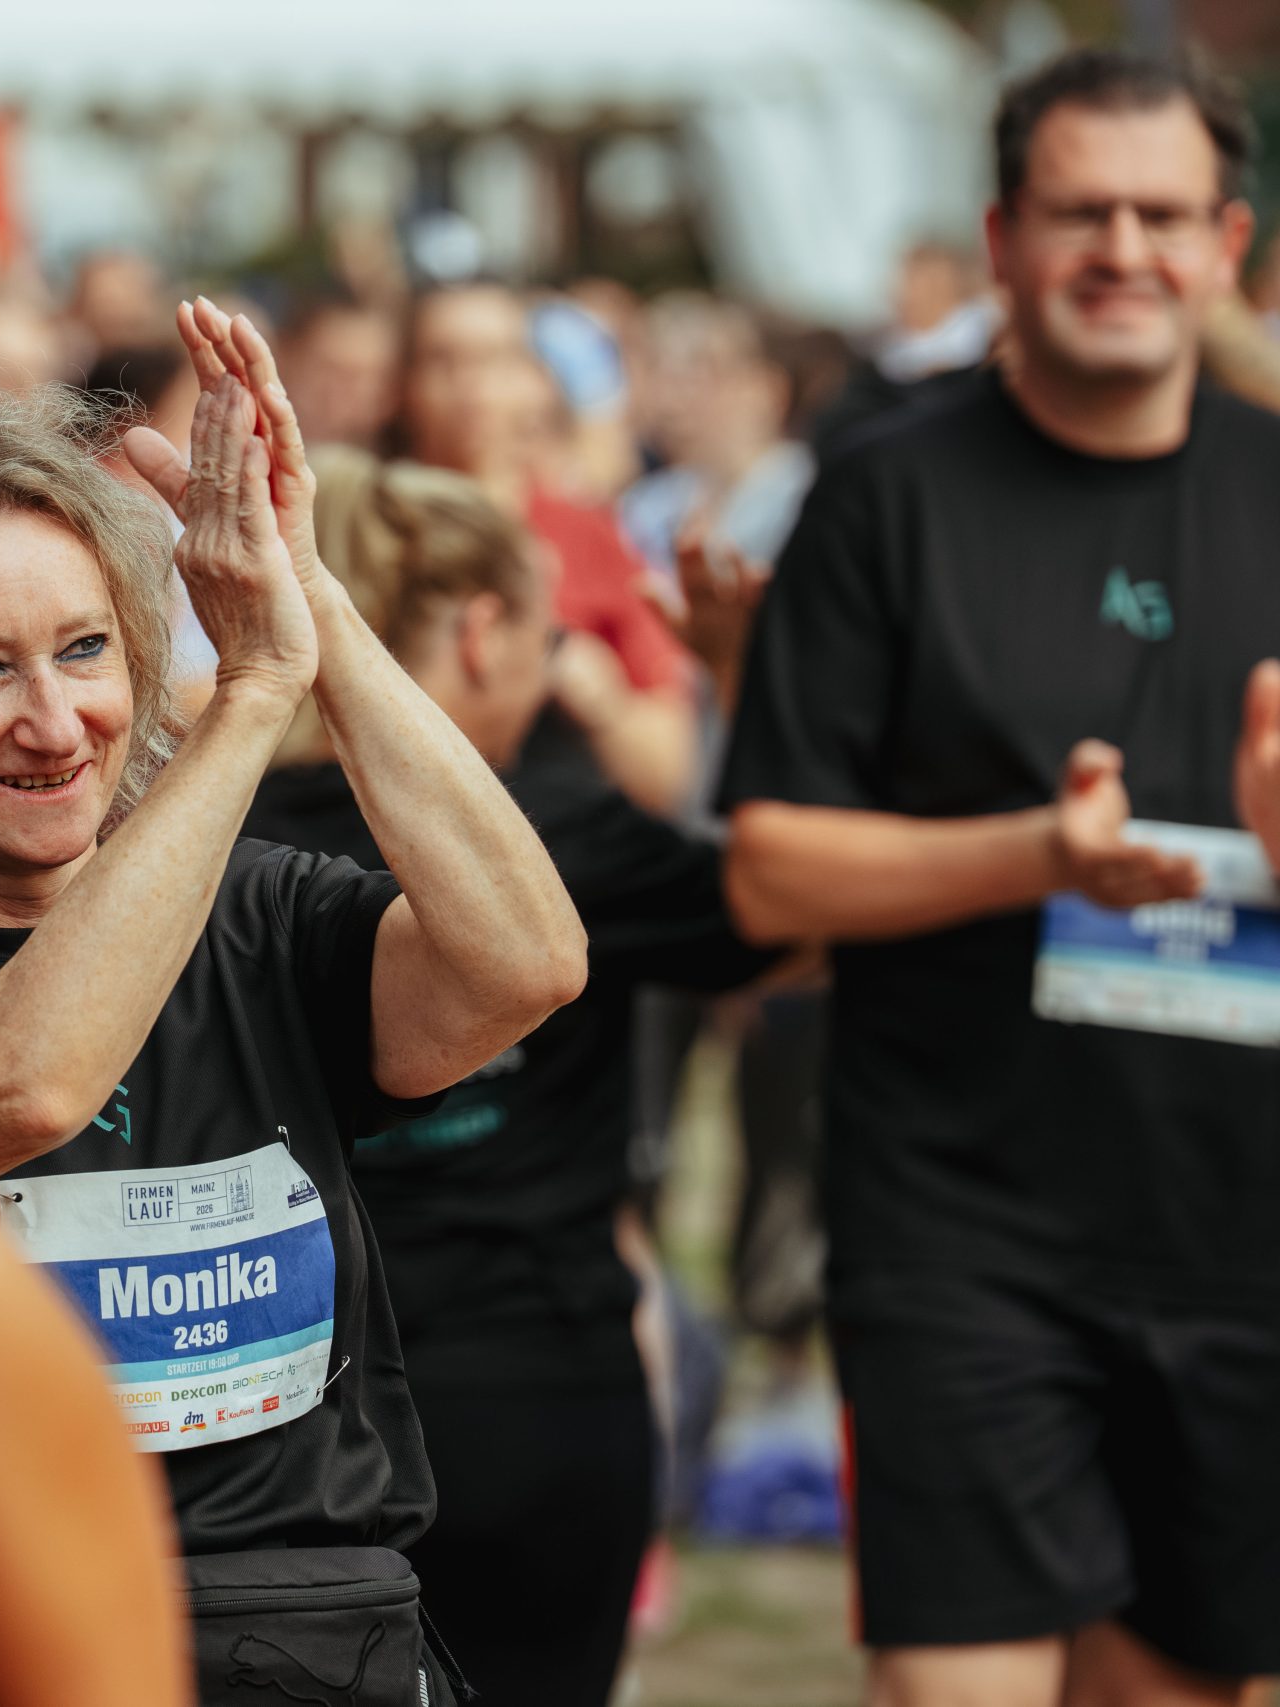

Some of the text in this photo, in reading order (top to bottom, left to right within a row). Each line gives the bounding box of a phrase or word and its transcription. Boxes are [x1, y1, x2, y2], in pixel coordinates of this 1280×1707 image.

[127, 1185, 173, 1200] FIRMEN
[191, 1181, 215, 1195] MAINZ
[129, 1200, 173, 1220] LAUF
[196, 1204, 213, 1215] 2026
[190, 1212, 255, 1232] WWW.FIRMENLAUF-MAINZ.DE
[98, 1252, 277, 1319] Monika
[173, 1319, 228, 1350] 2436
[167, 1359, 207, 1376] STARTZEIT
[227, 1352, 240, 1366] UHR
[184, 1411, 204, 1425] dm
